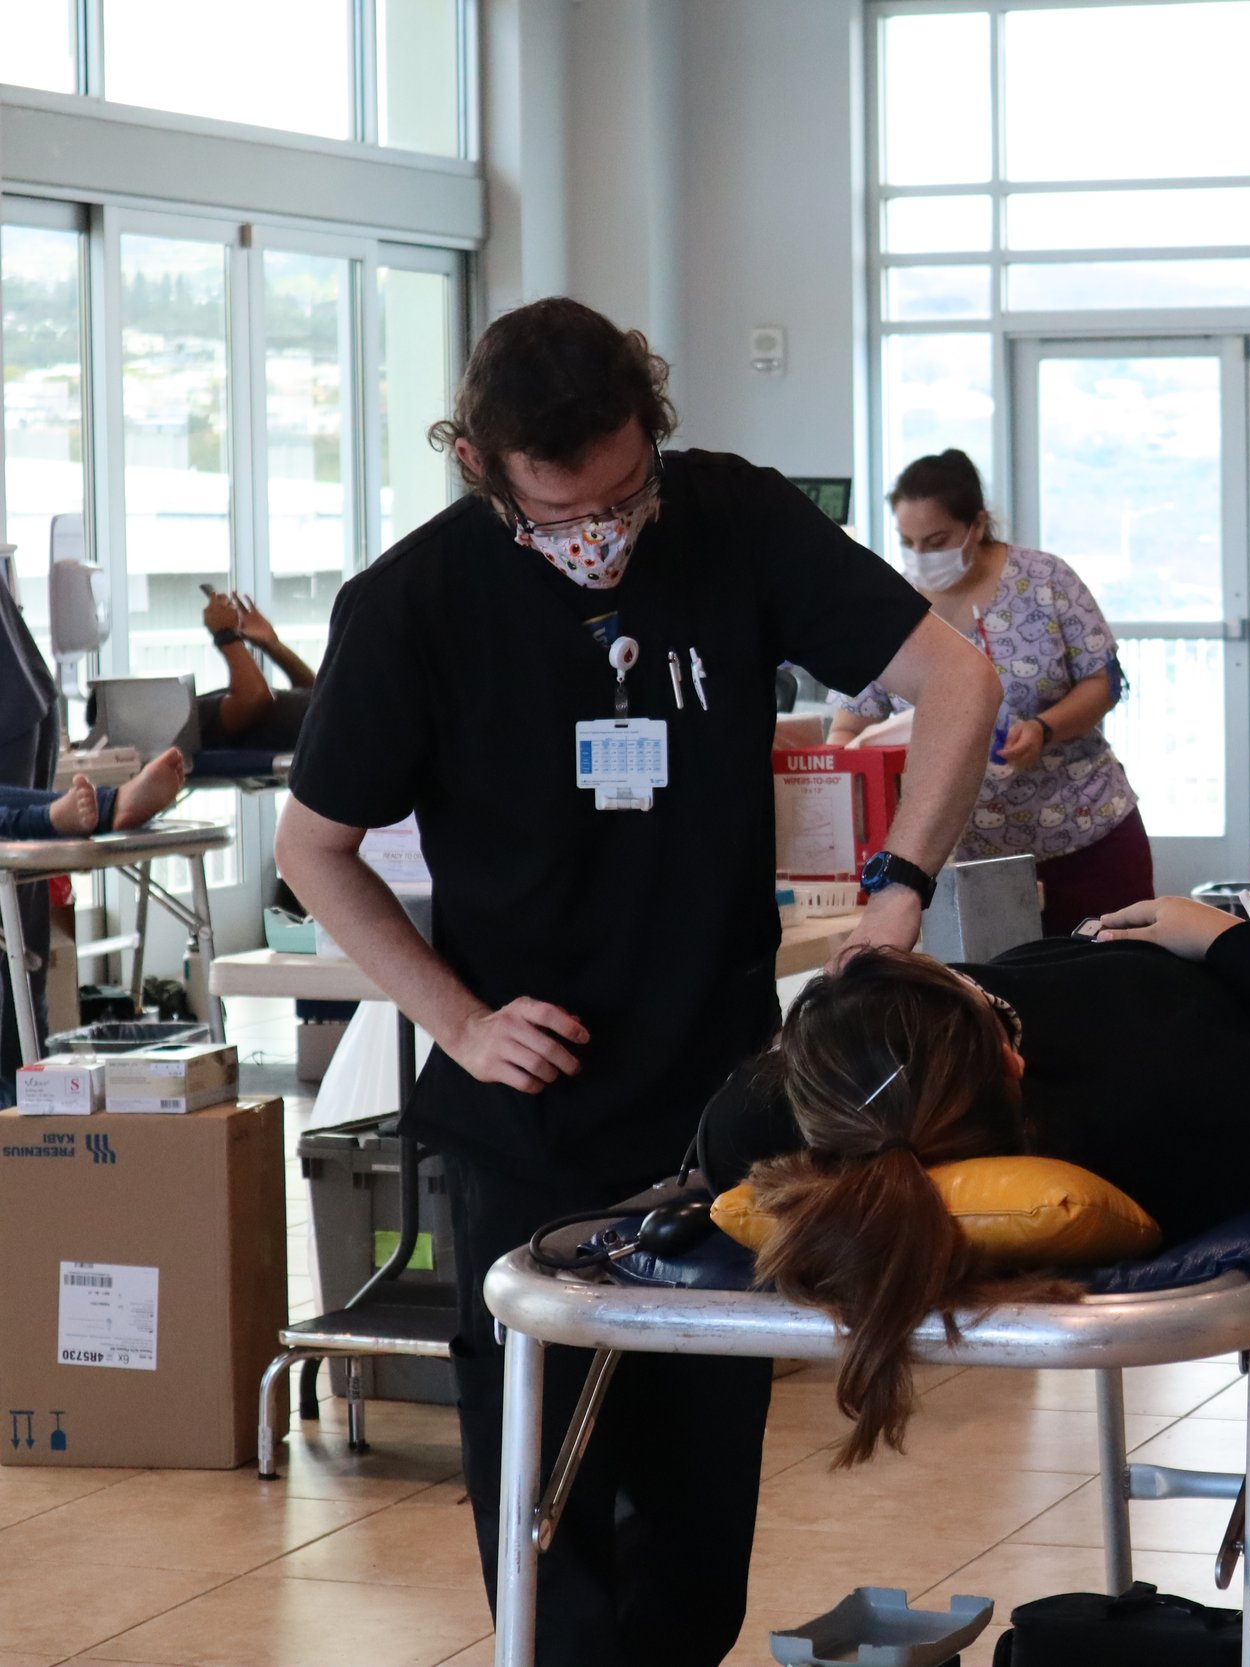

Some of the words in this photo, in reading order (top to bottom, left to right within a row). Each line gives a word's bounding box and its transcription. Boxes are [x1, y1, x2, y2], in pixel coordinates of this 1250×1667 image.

[787, 755, 834, 771] ULINE
[43, 1133, 75, 1144] KABI
[3, 1146, 75, 1157] FRESENIUS
[62, 1349, 104, 1363] 4R5730
